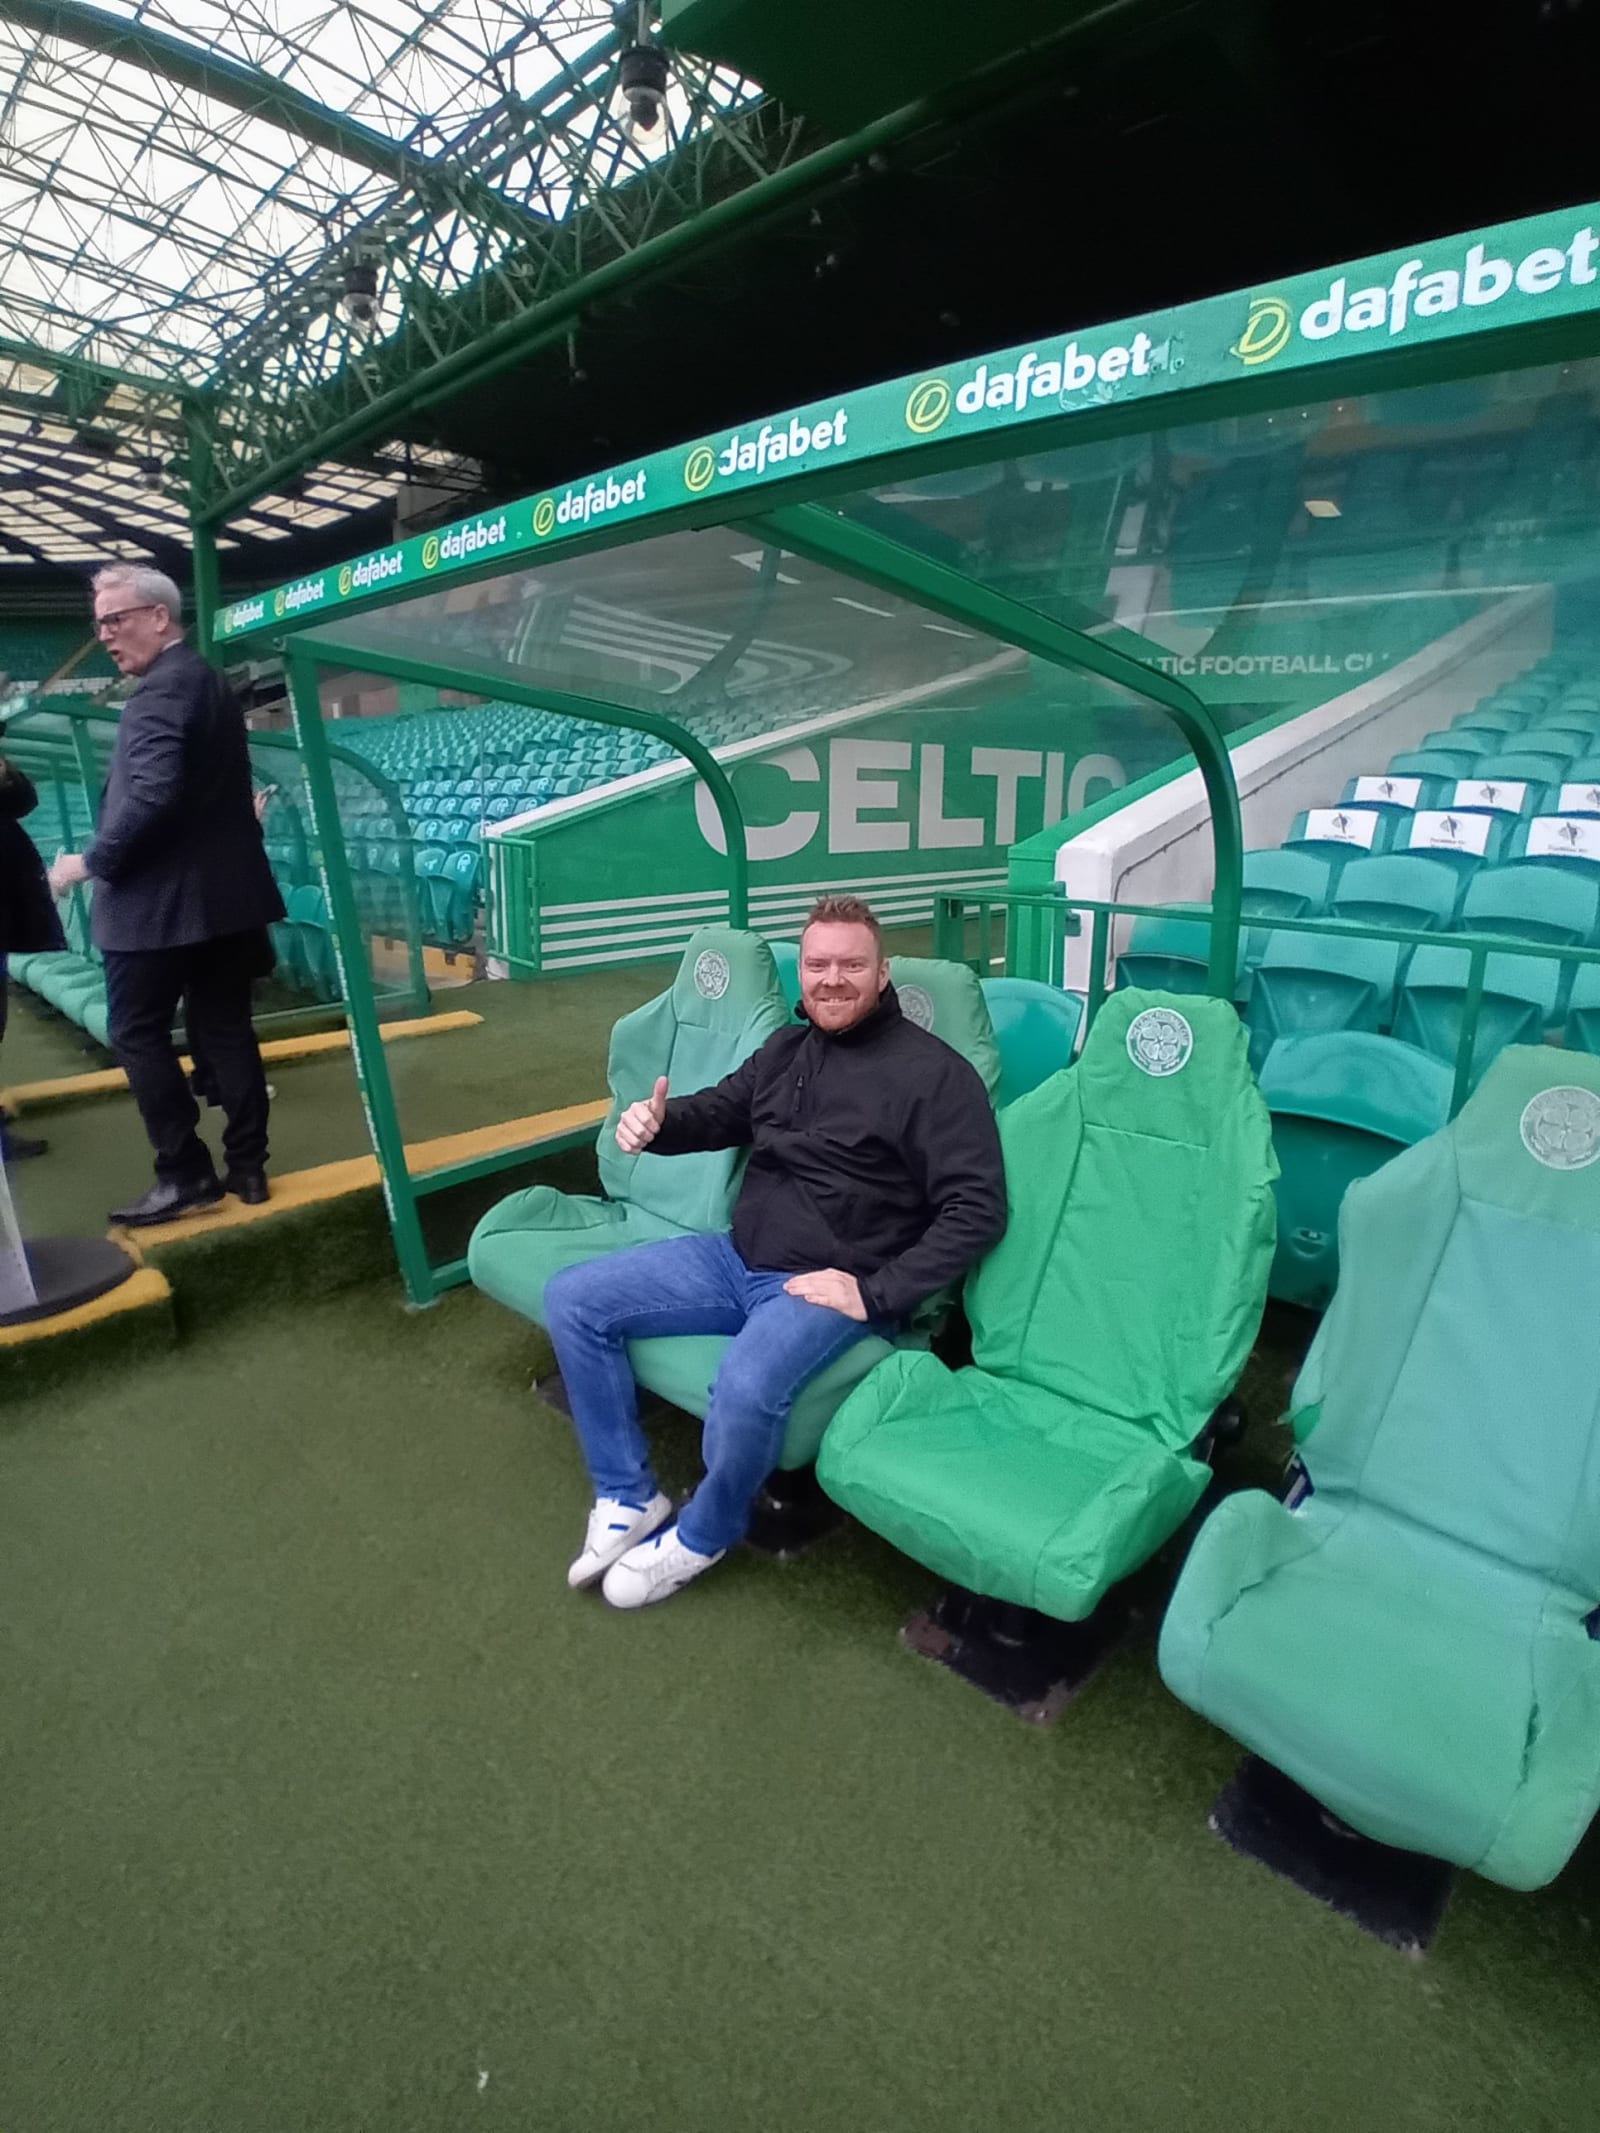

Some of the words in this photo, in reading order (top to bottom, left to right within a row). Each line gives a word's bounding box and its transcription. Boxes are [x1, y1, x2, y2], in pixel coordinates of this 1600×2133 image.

[352, 550, 403, 587] dafabet
[440, 516, 506, 559] dafabet
[556, 469, 646, 523] dafabet
[717, 407, 848, 476] dafabet
[955, 332, 1151, 414] dafabet
[1299, 226, 1599, 340] dafabet
[1200, 655, 1340, 676] FOOTBALL
